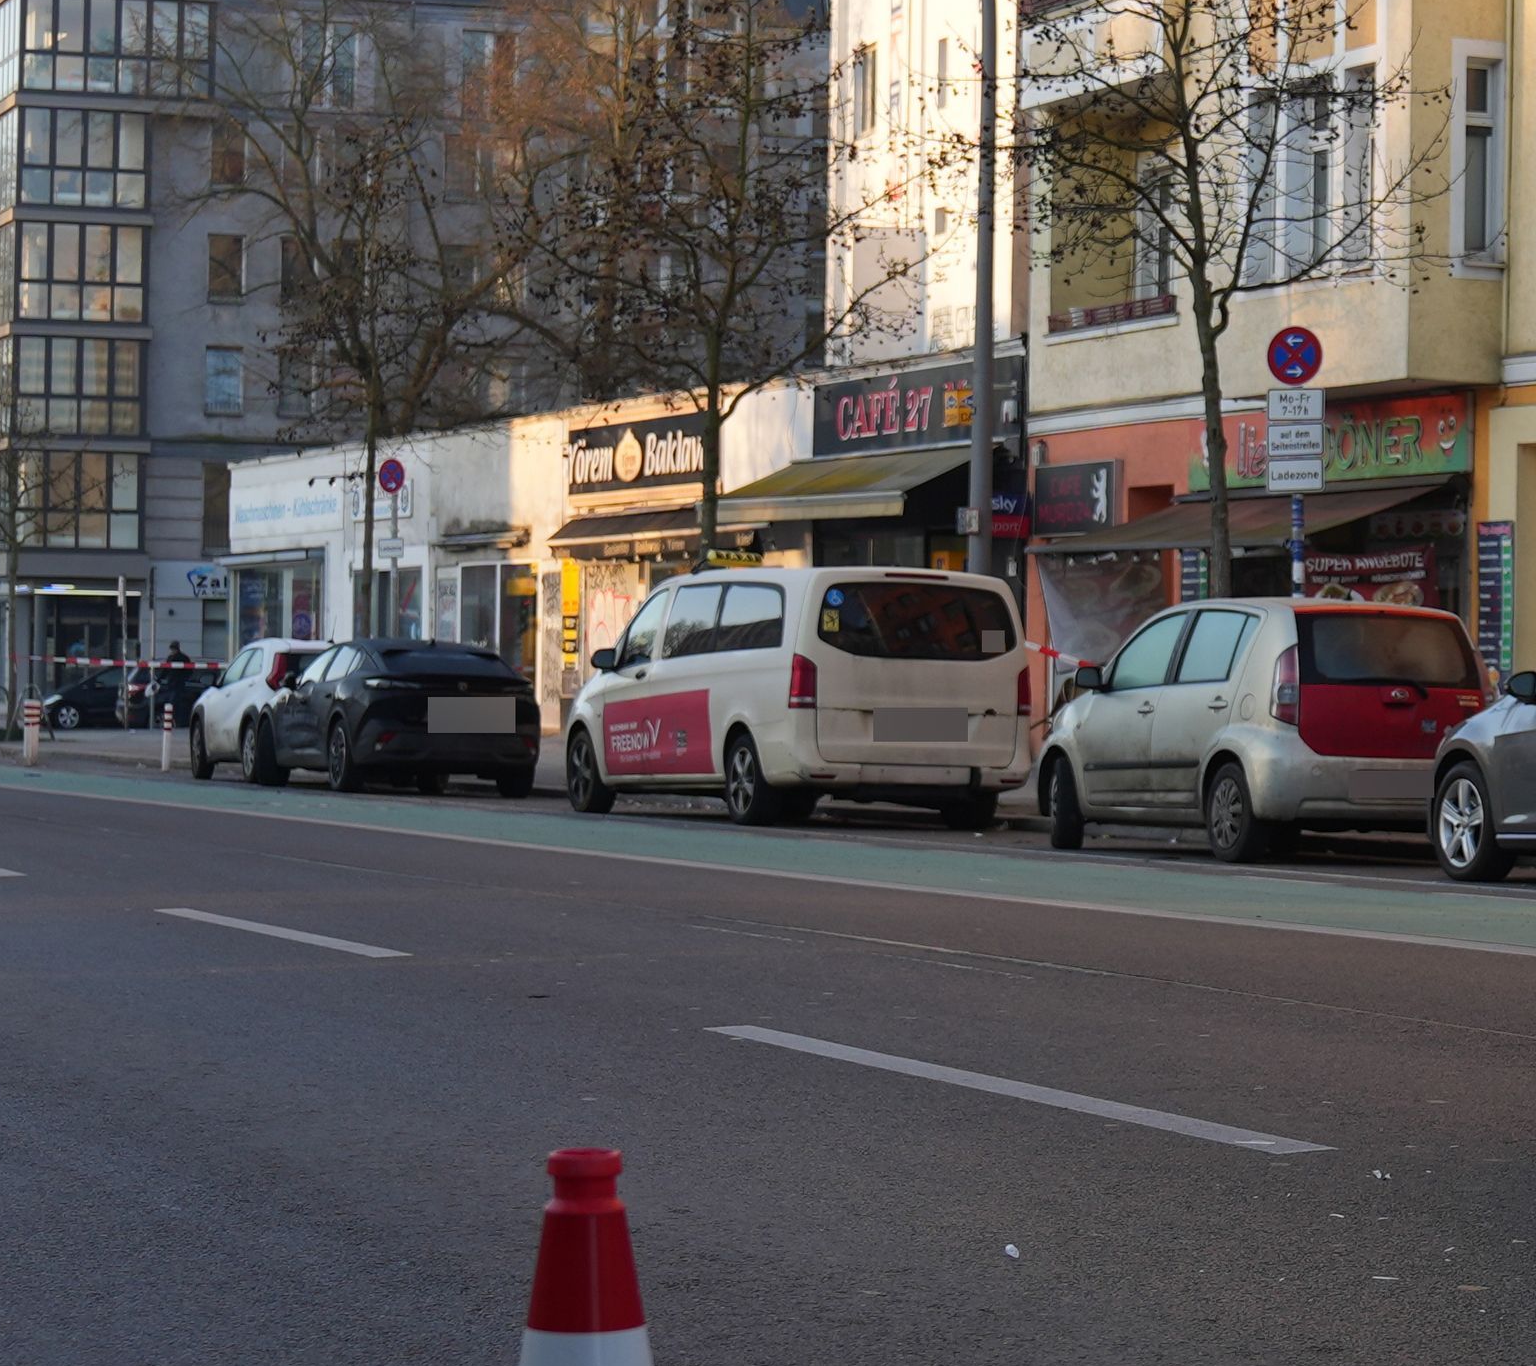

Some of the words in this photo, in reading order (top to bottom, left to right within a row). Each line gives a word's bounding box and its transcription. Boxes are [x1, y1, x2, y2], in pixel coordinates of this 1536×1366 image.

[836, 376, 900, 441] CAFÉ
[904, 386, 933, 432] 27
[1279, 394, 1311, 404] Mo-Fr
[1280, 431, 1292, 439] auf
[1295, 430, 1310, 438] dem
[1272, 441, 1320, 451] Seitenstreifen
[568, 438, 614, 485] Yörem
[1272, 470, 1319, 481] Ladezone
[992, 495, 1017, 514] sky
[1305, 555, 1352, 573] SUPER
[1356, 551, 1425, 569] ANGEBOTE
[611, 732, 650, 753] FREENOW
